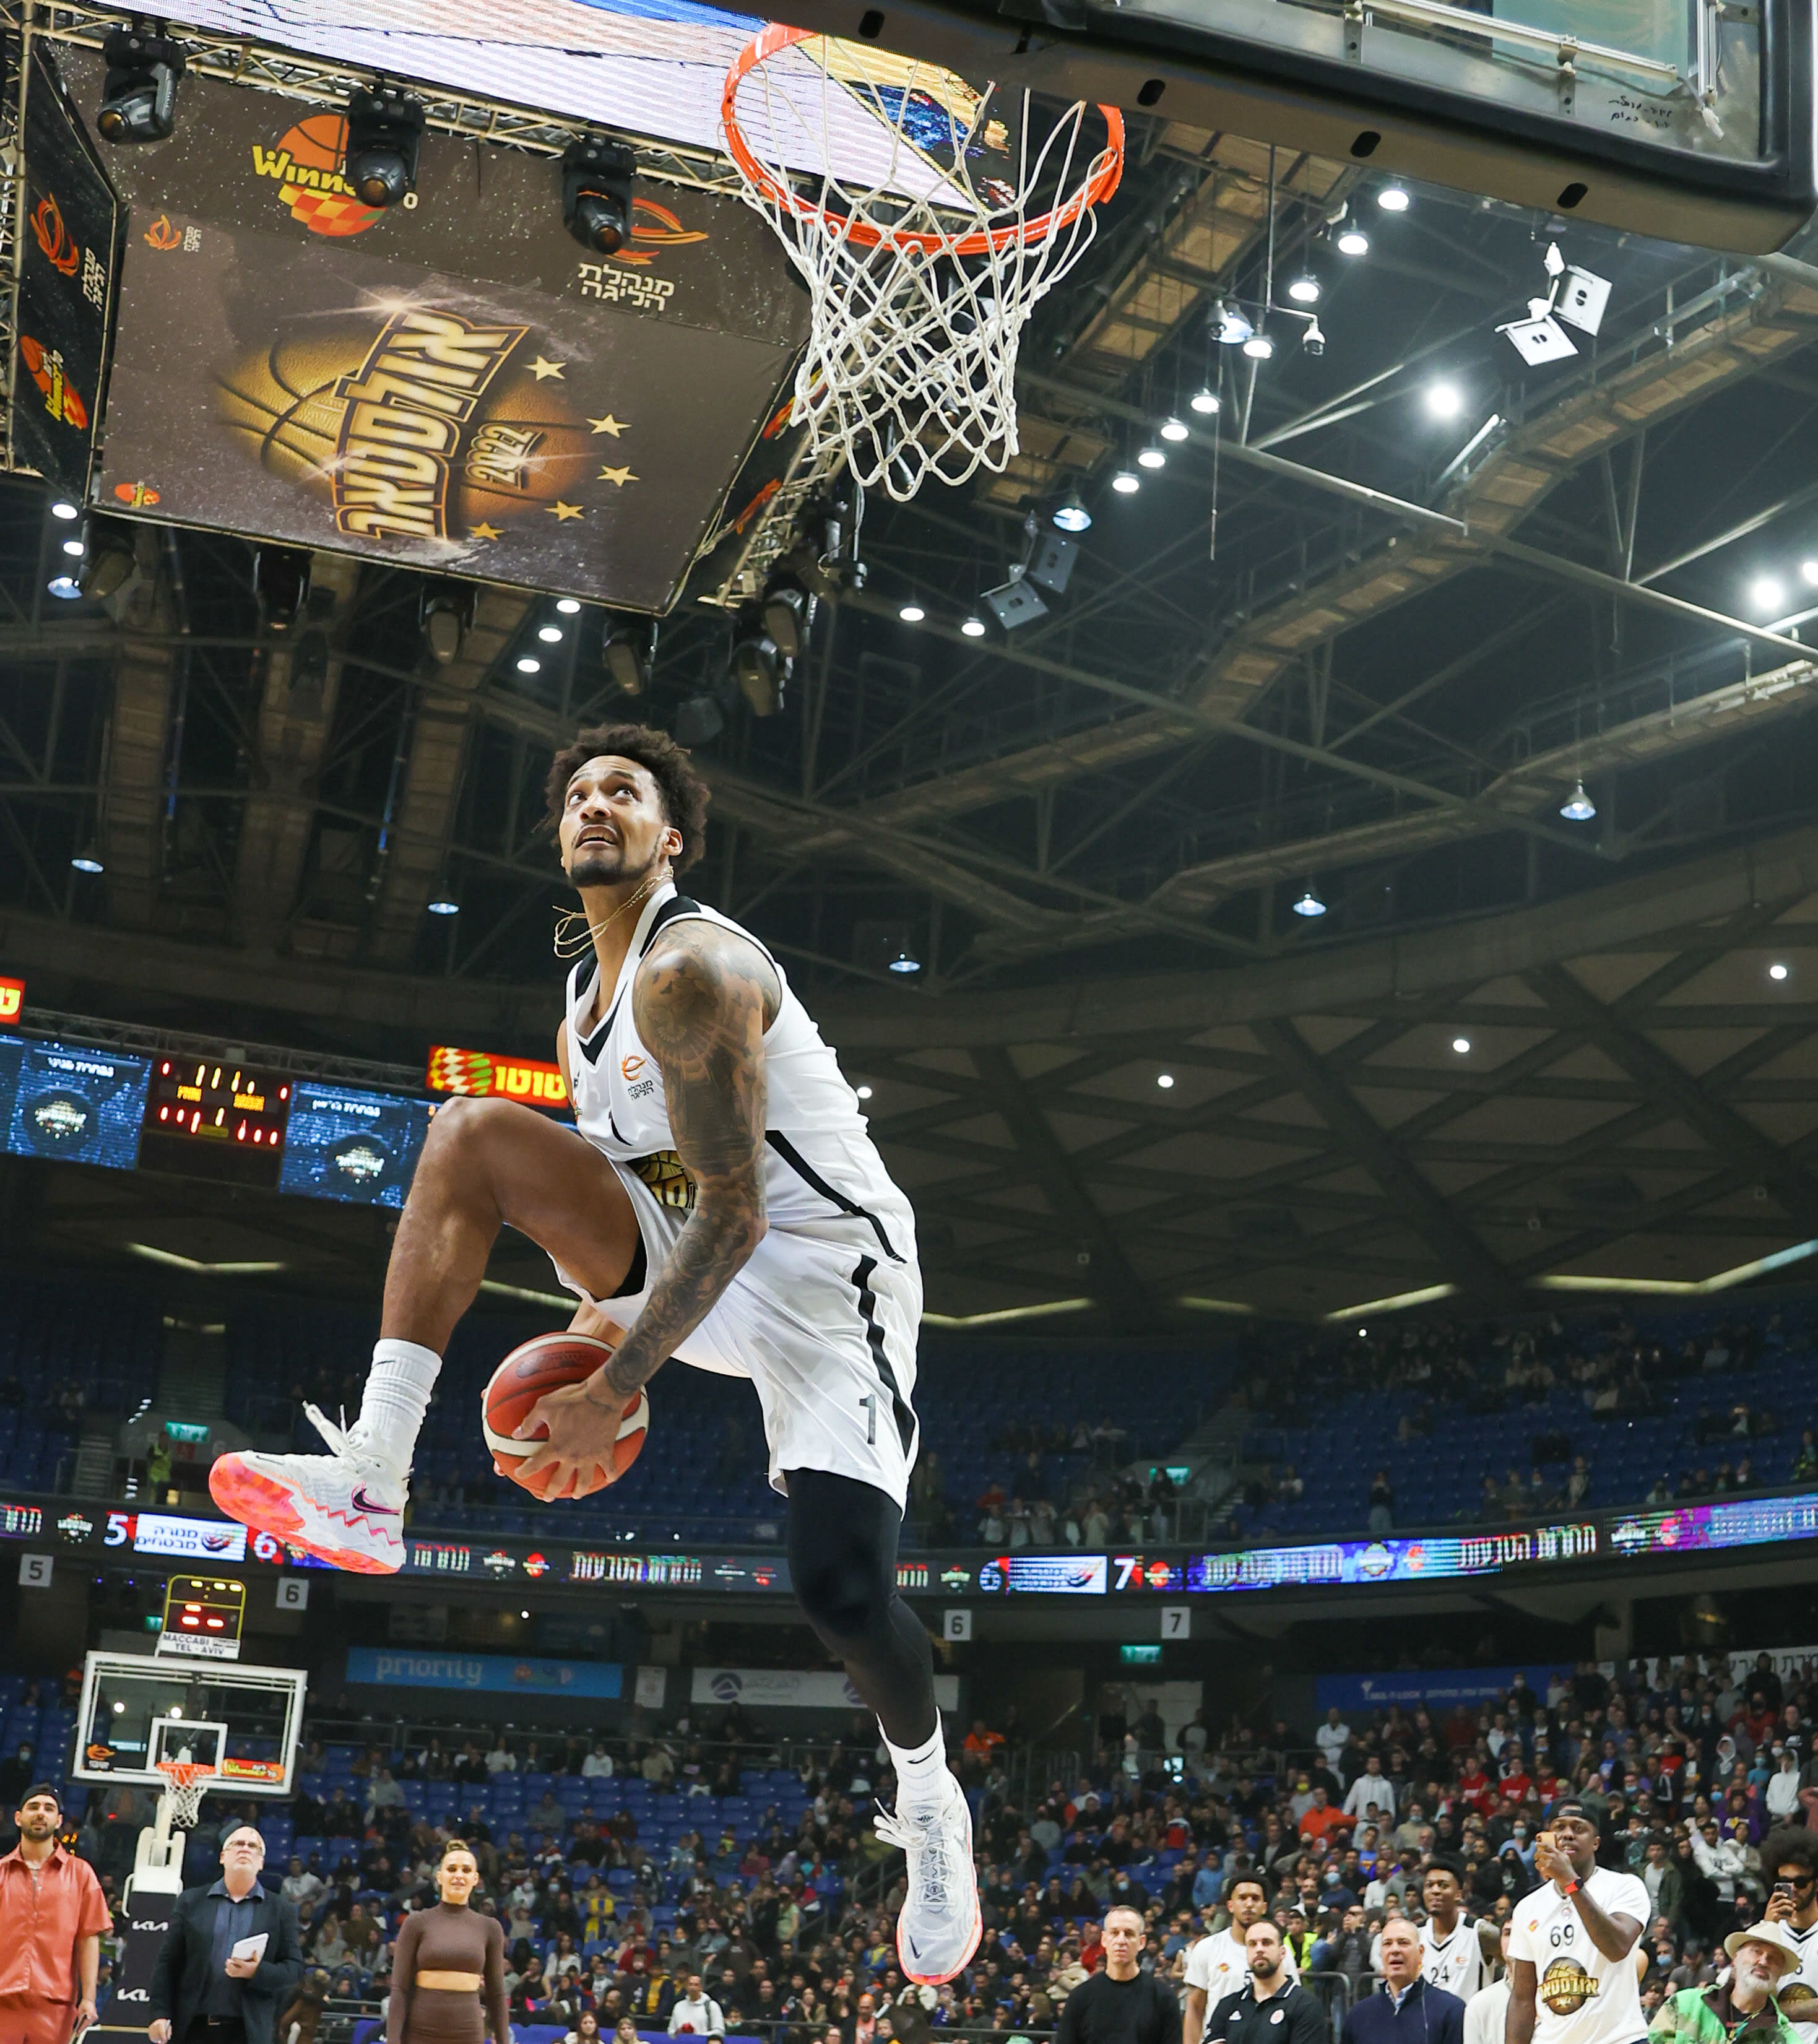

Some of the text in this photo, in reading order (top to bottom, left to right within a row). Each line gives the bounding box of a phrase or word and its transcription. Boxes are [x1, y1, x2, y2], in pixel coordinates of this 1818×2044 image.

[253, 145, 357, 197] Winn
[577, 262, 675, 297] מנהלת
[581, 279, 666, 312] הליגה
[338, 308, 519, 540] אולסטאר
[467, 423, 541, 488] 2022
[495, 1065, 568, 1101] טוטו
[627, 1080, 654, 1094] מנהלת
[630, 1086, 655, 1101] הליגה
[859, 1393, 876, 1445] 1
[103, 1514, 129, 1546] 5
[154, 1526, 198, 1538] מנורה
[135, 1536, 197, 1550] מבטחים
[254, 1531, 277, 1559] 6
[29, 1561, 43, 1580] 5
[979, 1559, 1002, 1591] 6
[1114, 1557, 1135, 1591] 7
[285, 1583, 300, 1603] 6
[951, 1616, 963, 1634] 6
[1170, 1613, 1183, 1632] 7
[162, 1633, 210, 1645] MACCABI
[176, 1643, 192, 1652] TEL
[201, 1646, 225, 1655] AVIV
[376, 1655, 485, 1687] priority
[1550, 1924, 1575, 1947] 69
[1431, 1964, 1450, 1986] 24
